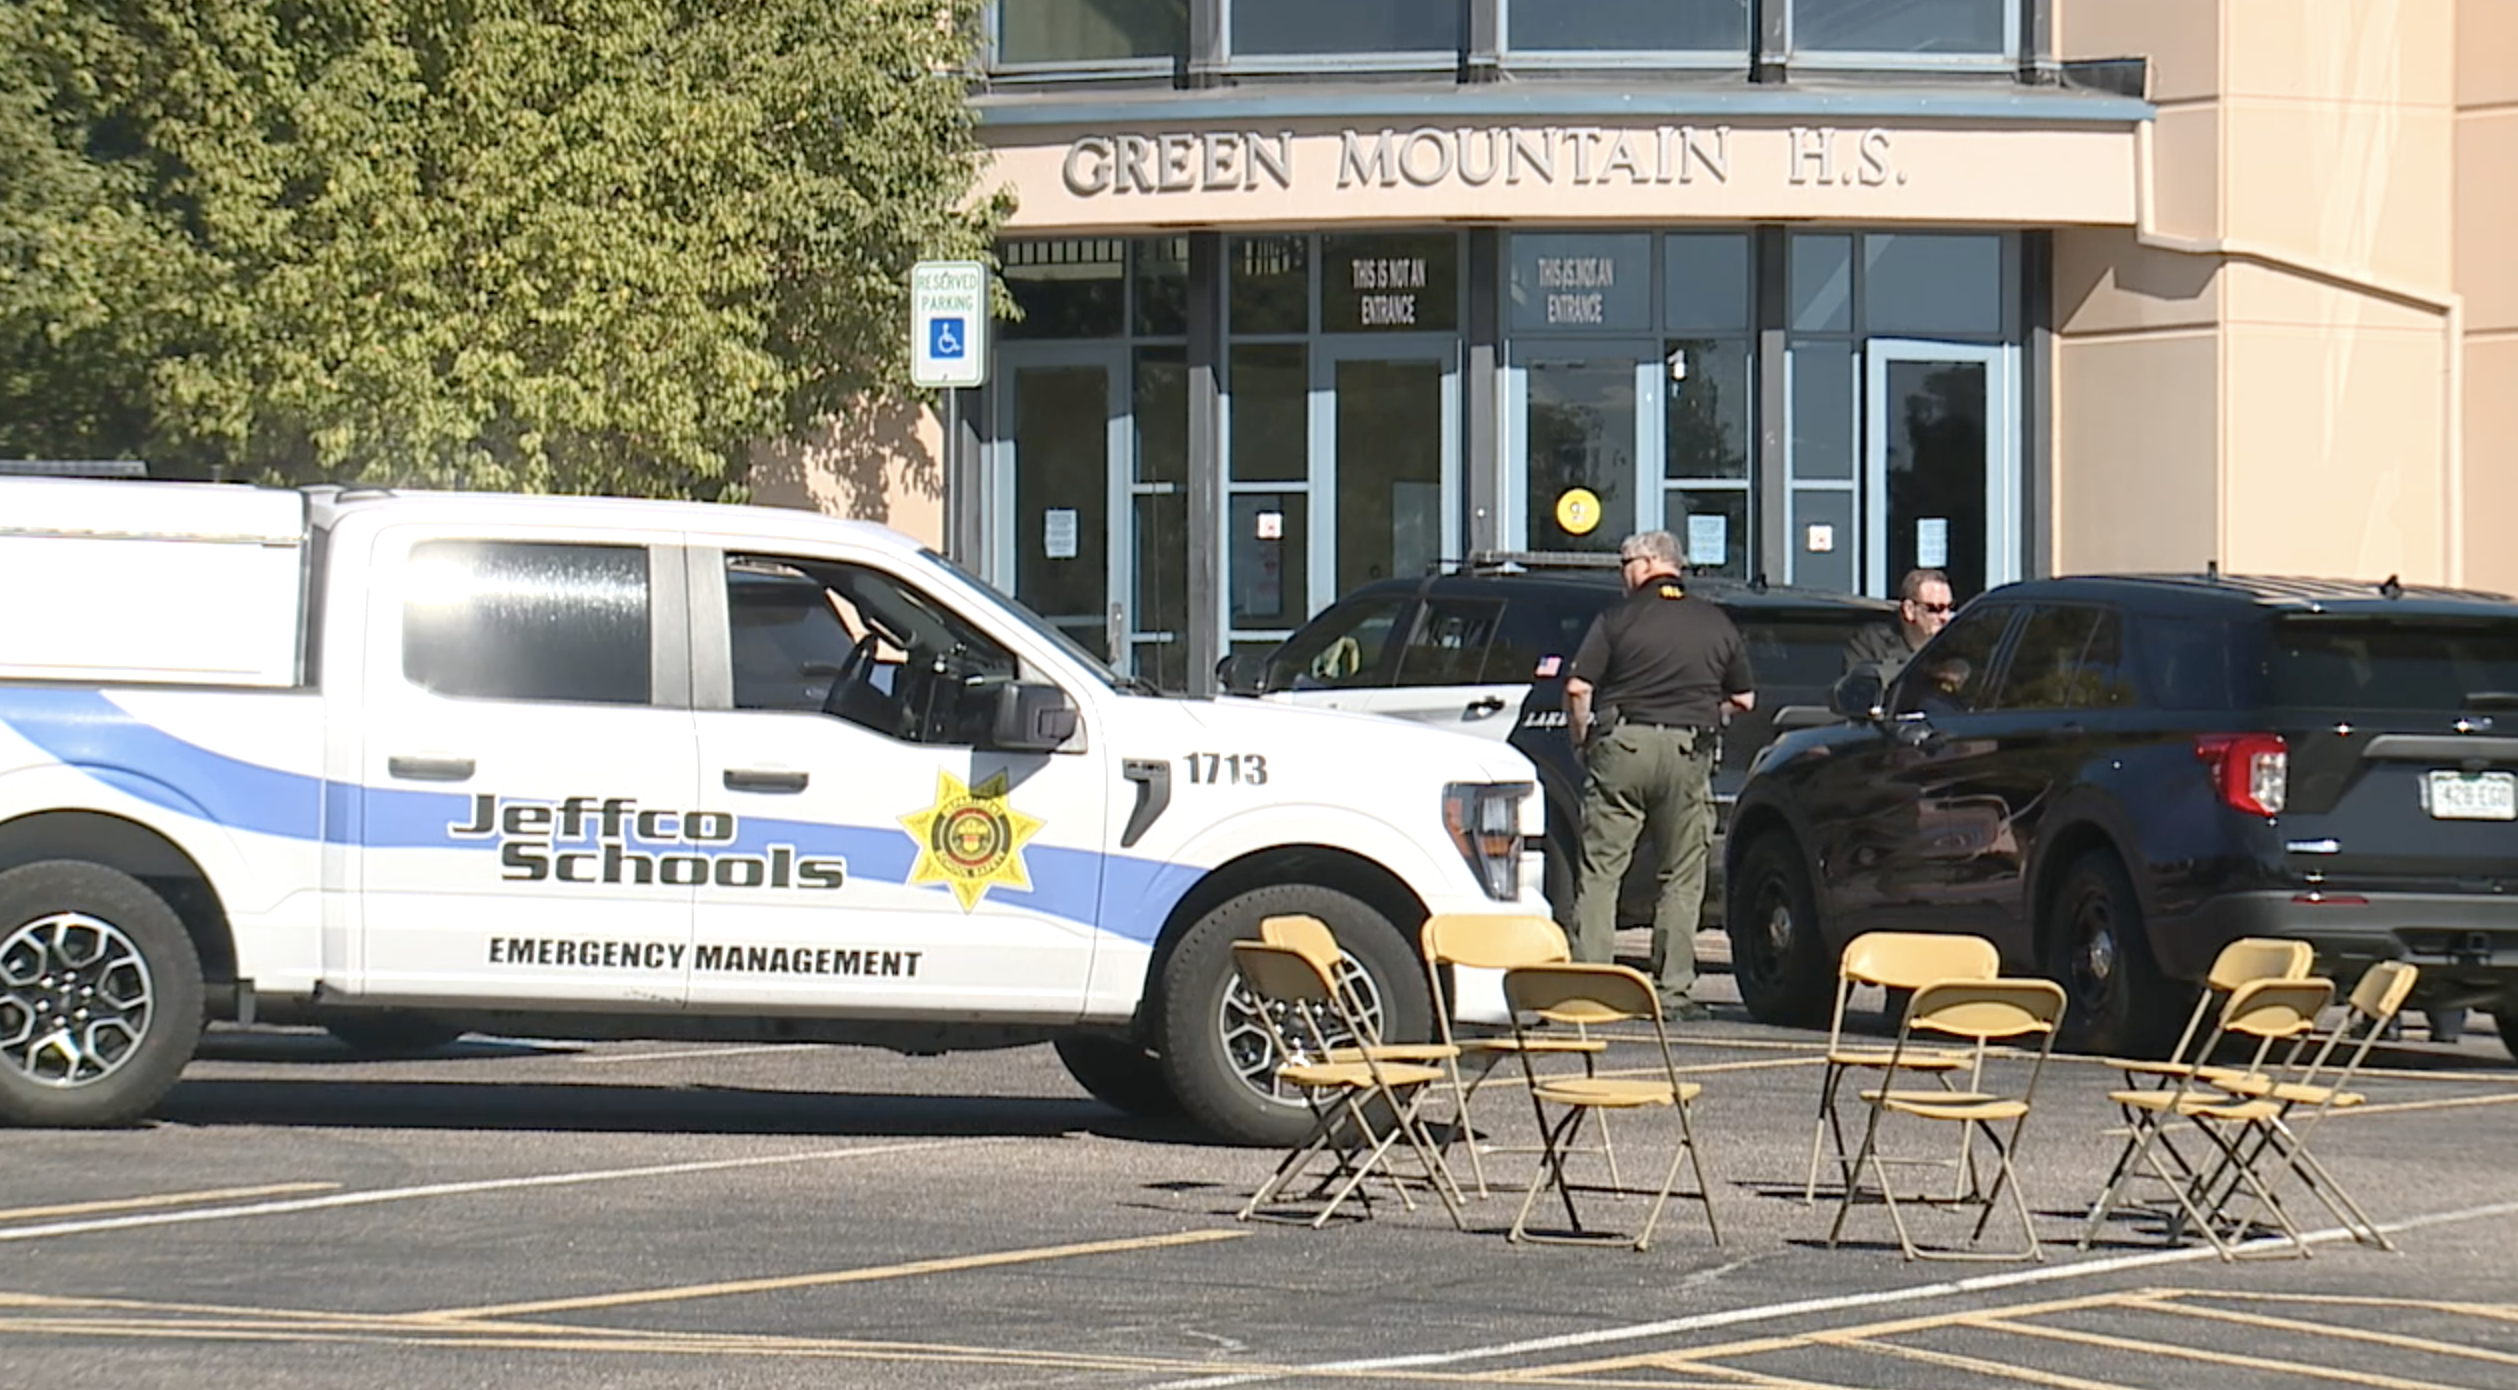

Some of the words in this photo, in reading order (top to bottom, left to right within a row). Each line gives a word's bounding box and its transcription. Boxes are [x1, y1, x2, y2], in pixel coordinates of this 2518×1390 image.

[1063, 131, 1293, 196] GREEN
[1336, 126, 1730, 186] MOUNTAIN
[1789, 126, 1907, 187] H.S.
[917, 274, 977, 291] RESERVED
[1352, 258, 1375, 289] THIS
[1377, 258, 1388, 288] IS
[1389, 258, 1409, 288] NOT
[1410, 258, 1425, 288] AN
[1538, 258, 1561, 287] THIS
[1597, 258, 1613, 287] AN
[921, 295, 974, 312] PARKING
[1361, 295, 1415, 325] ENTRANCE
[1548, 294, 1603, 323] ENTRANCE
[1182, 751, 1268, 786] 1713
[452, 794, 734, 841] Jeffco
[501, 841, 844, 889] Schools
[489, 937, 686, 969] EMERGENCY
[695, 945, 922, 977] MANAGEMENT
